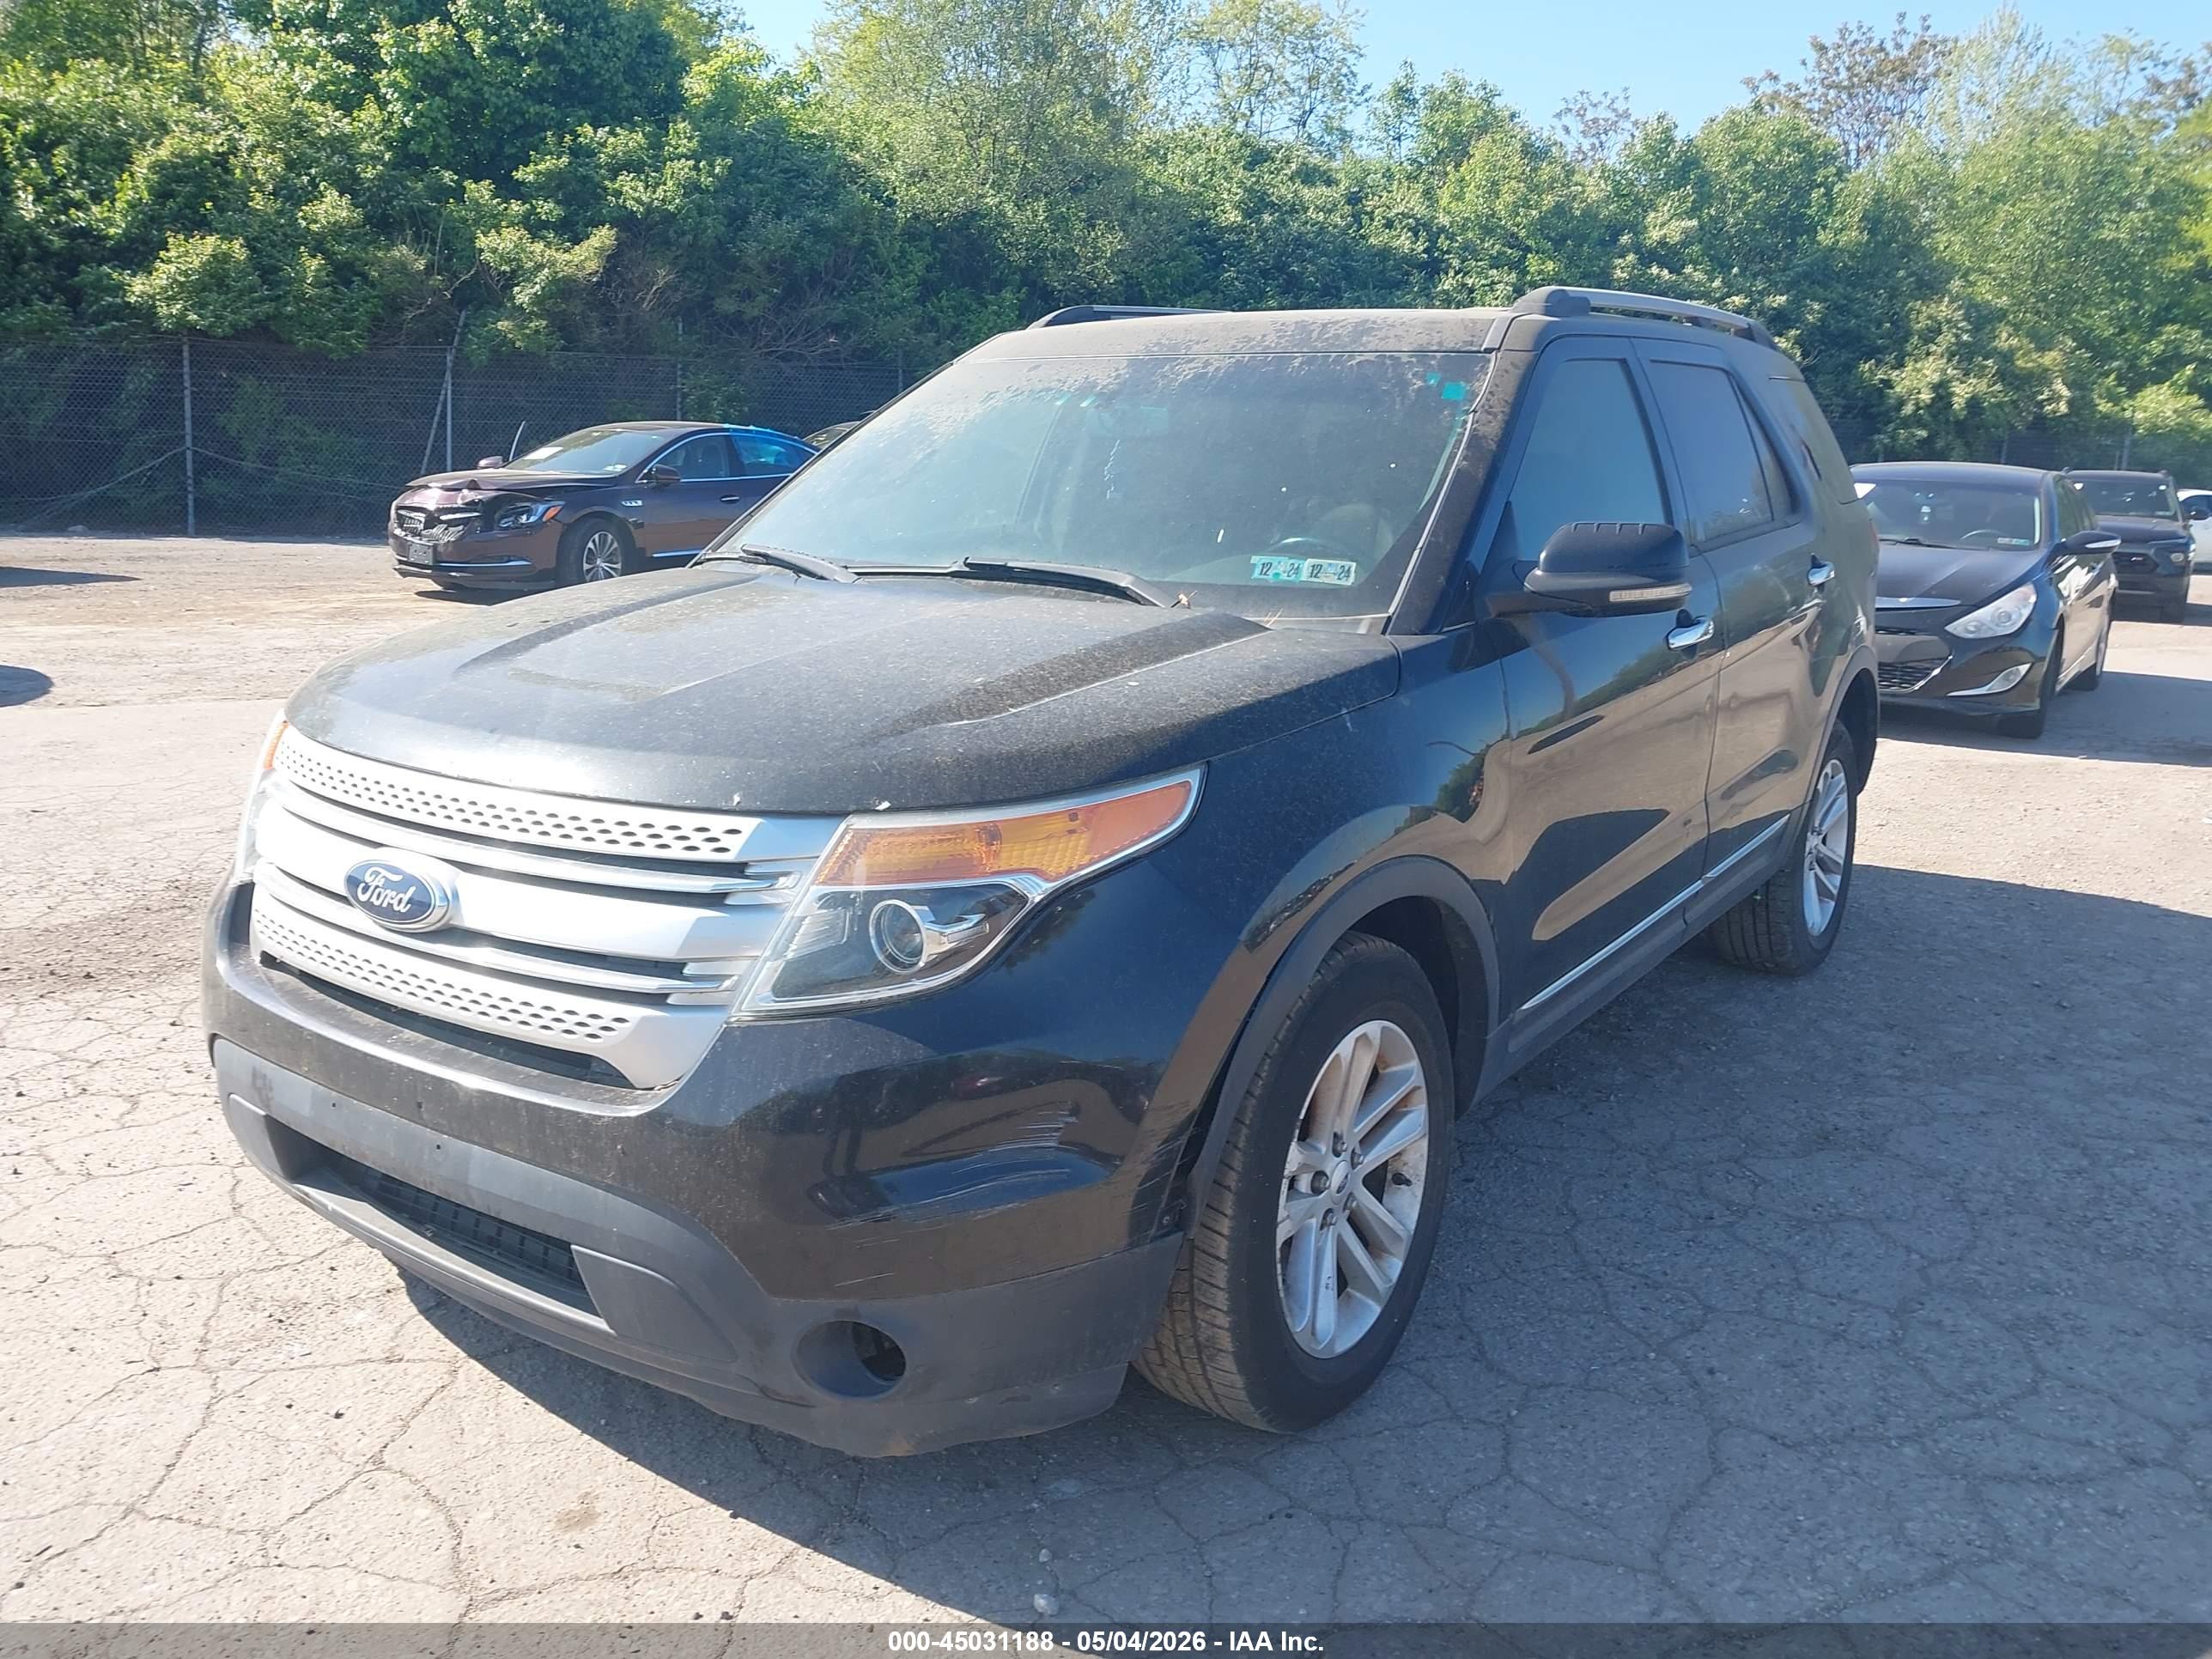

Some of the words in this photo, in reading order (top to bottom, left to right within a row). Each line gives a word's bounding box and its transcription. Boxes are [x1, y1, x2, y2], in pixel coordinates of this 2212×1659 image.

[1259, 562, 1273, 576] 12
[1310, 563, 1323, 579] 12
[1337, 565, 1353, 580] 24
[357, 866, 416, 913] Ford
